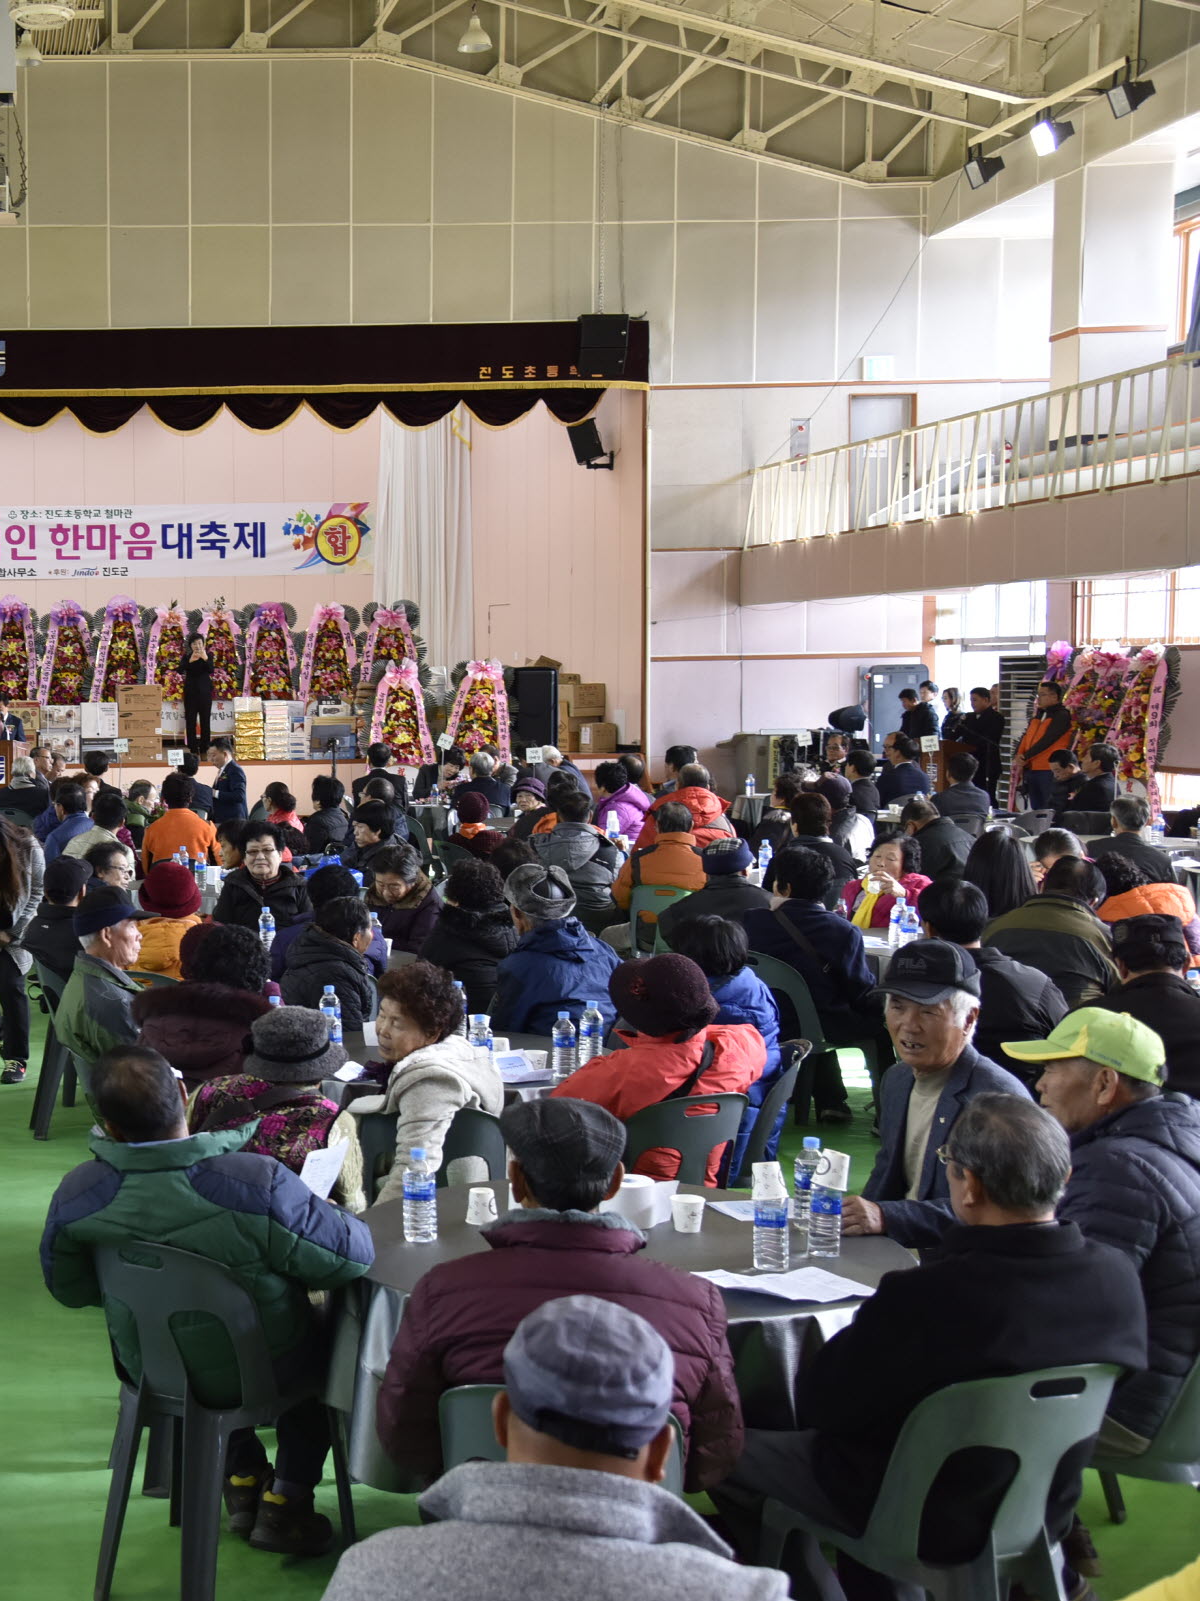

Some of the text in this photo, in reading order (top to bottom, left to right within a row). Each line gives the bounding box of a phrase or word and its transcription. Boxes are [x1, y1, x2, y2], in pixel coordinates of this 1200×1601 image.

[19, 509, 43, 520] 장소:
[44, 509, 102, 520] 진도초등학교
[104, 508, 133, 519] 철마관
[323, 525, 352, 559] 합
[53, 568, 69, 576] 후원:
[102, 567, 129, 577] 진도군
[898, 958, 927, 968] FILA
